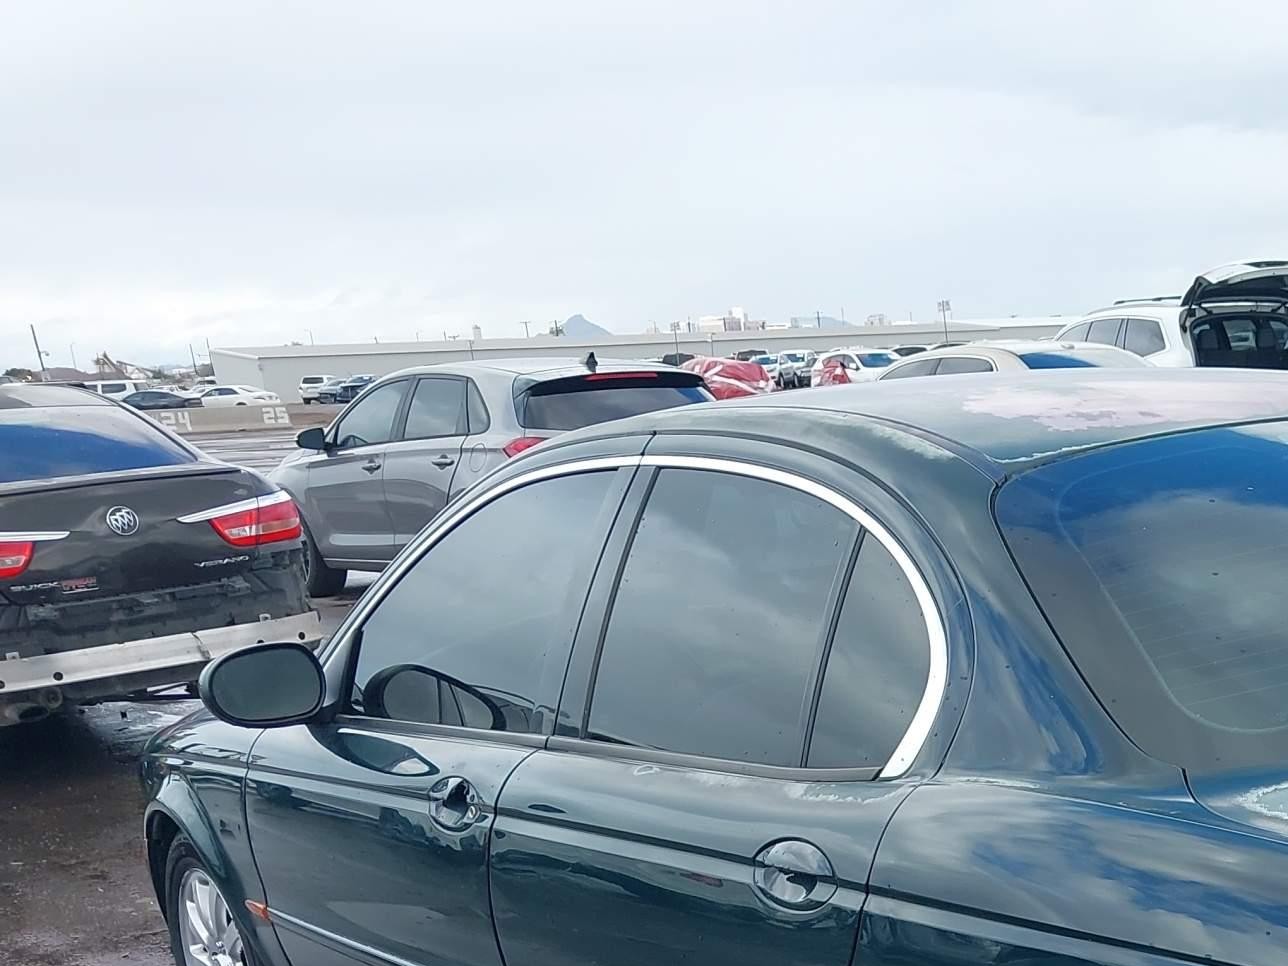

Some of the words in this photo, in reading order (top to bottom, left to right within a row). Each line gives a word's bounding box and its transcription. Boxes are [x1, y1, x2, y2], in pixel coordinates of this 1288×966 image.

[160, 411, 192, 431] 24
[262, 407, 290, 424] 25
[10, 581, 60, 592] BUICK
